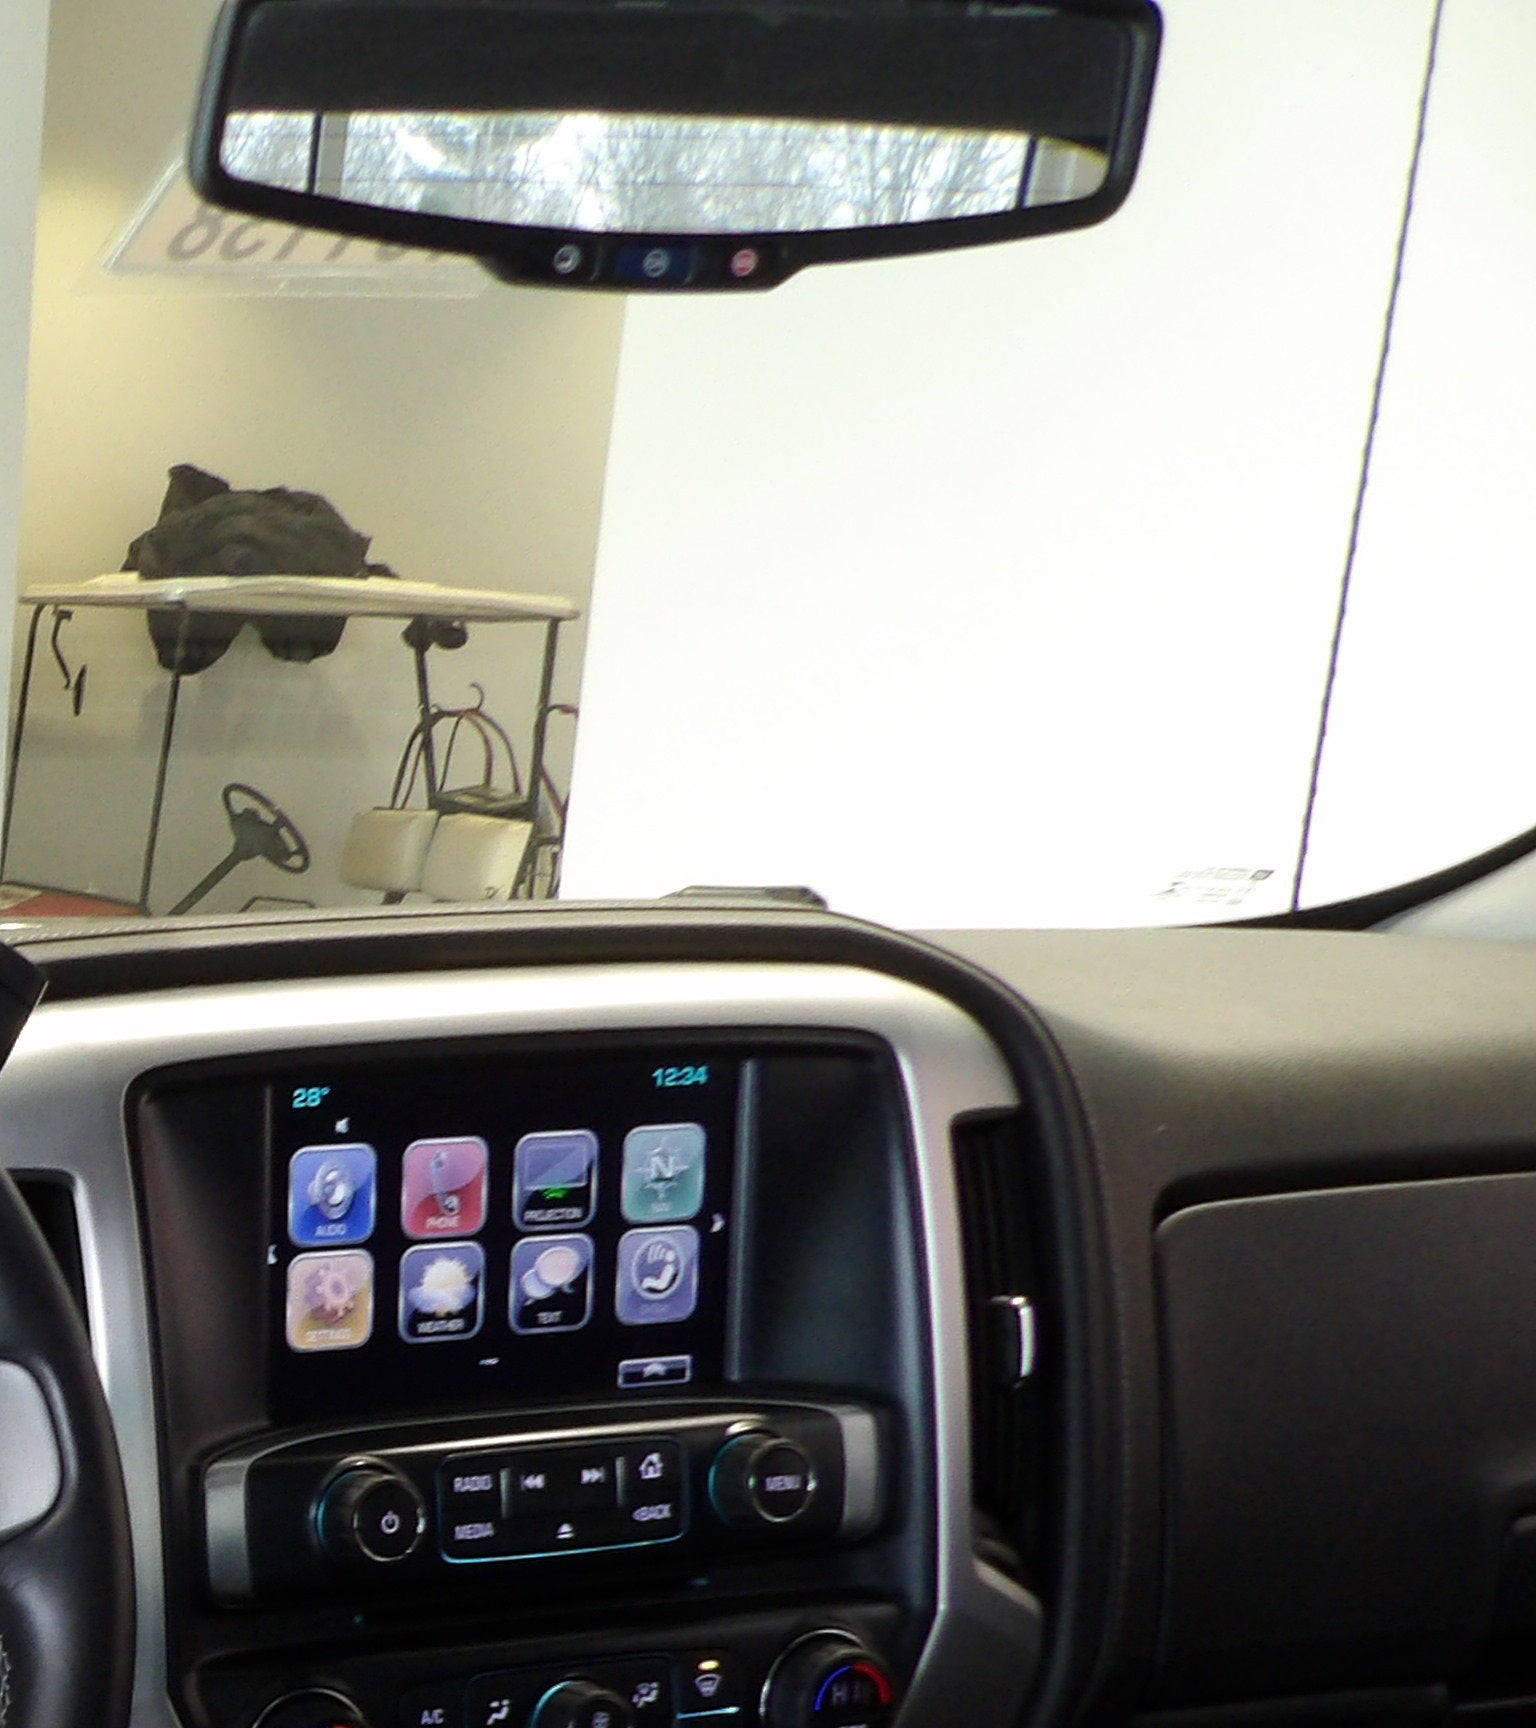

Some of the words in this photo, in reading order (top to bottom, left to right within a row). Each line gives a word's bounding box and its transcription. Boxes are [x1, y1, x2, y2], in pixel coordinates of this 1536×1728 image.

[453, 1474, 494, 1493] RADIO
[765, 1474, 803, 1492] MENU
[453, 1522, 494, 1541] MEDIA
[420, 1707, 445, 1726] A/C
